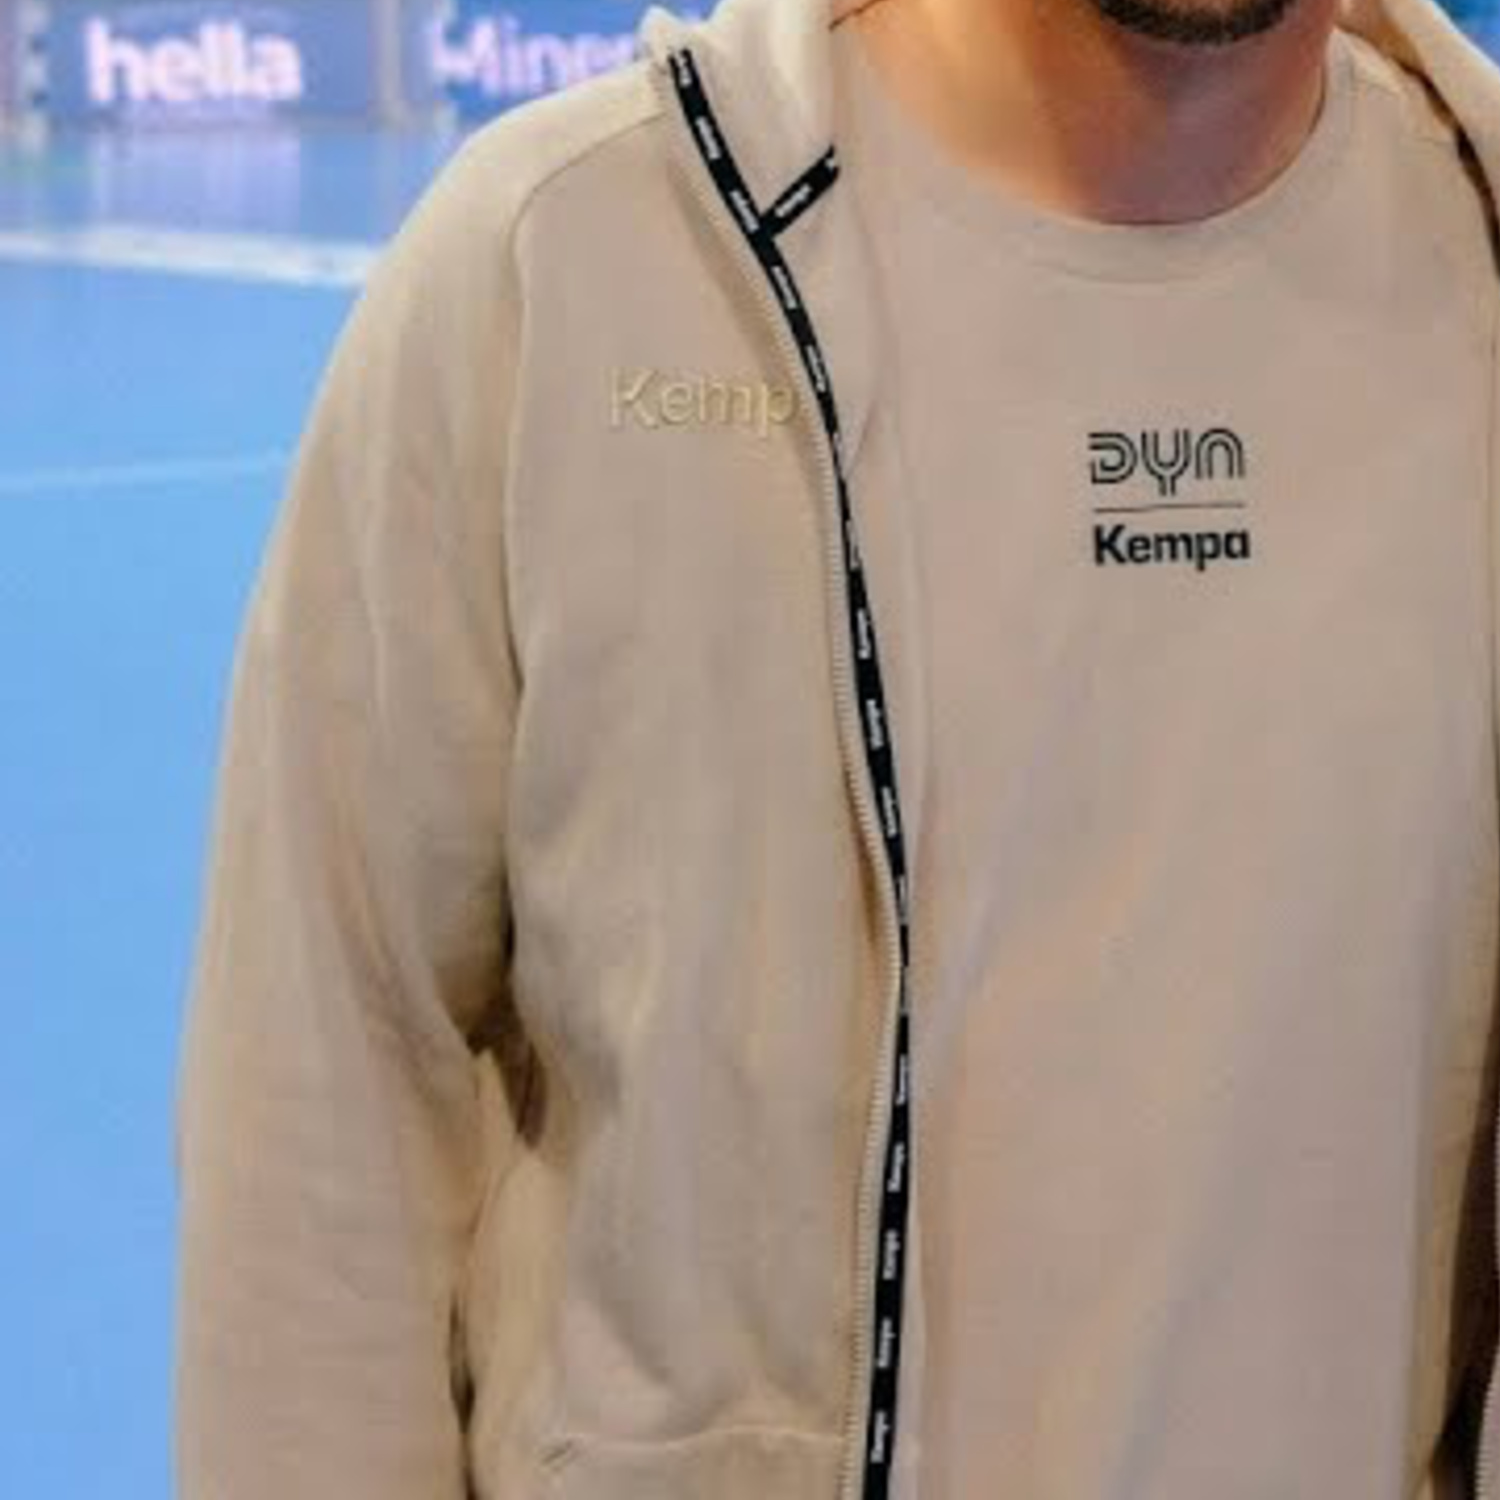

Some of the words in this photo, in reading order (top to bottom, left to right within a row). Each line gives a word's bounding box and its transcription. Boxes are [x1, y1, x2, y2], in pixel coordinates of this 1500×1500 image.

[86, 17, 304, 103] hella
[606, 366, 800, 442] Kemp
[1093, 522, 1251, 573] Kempa
